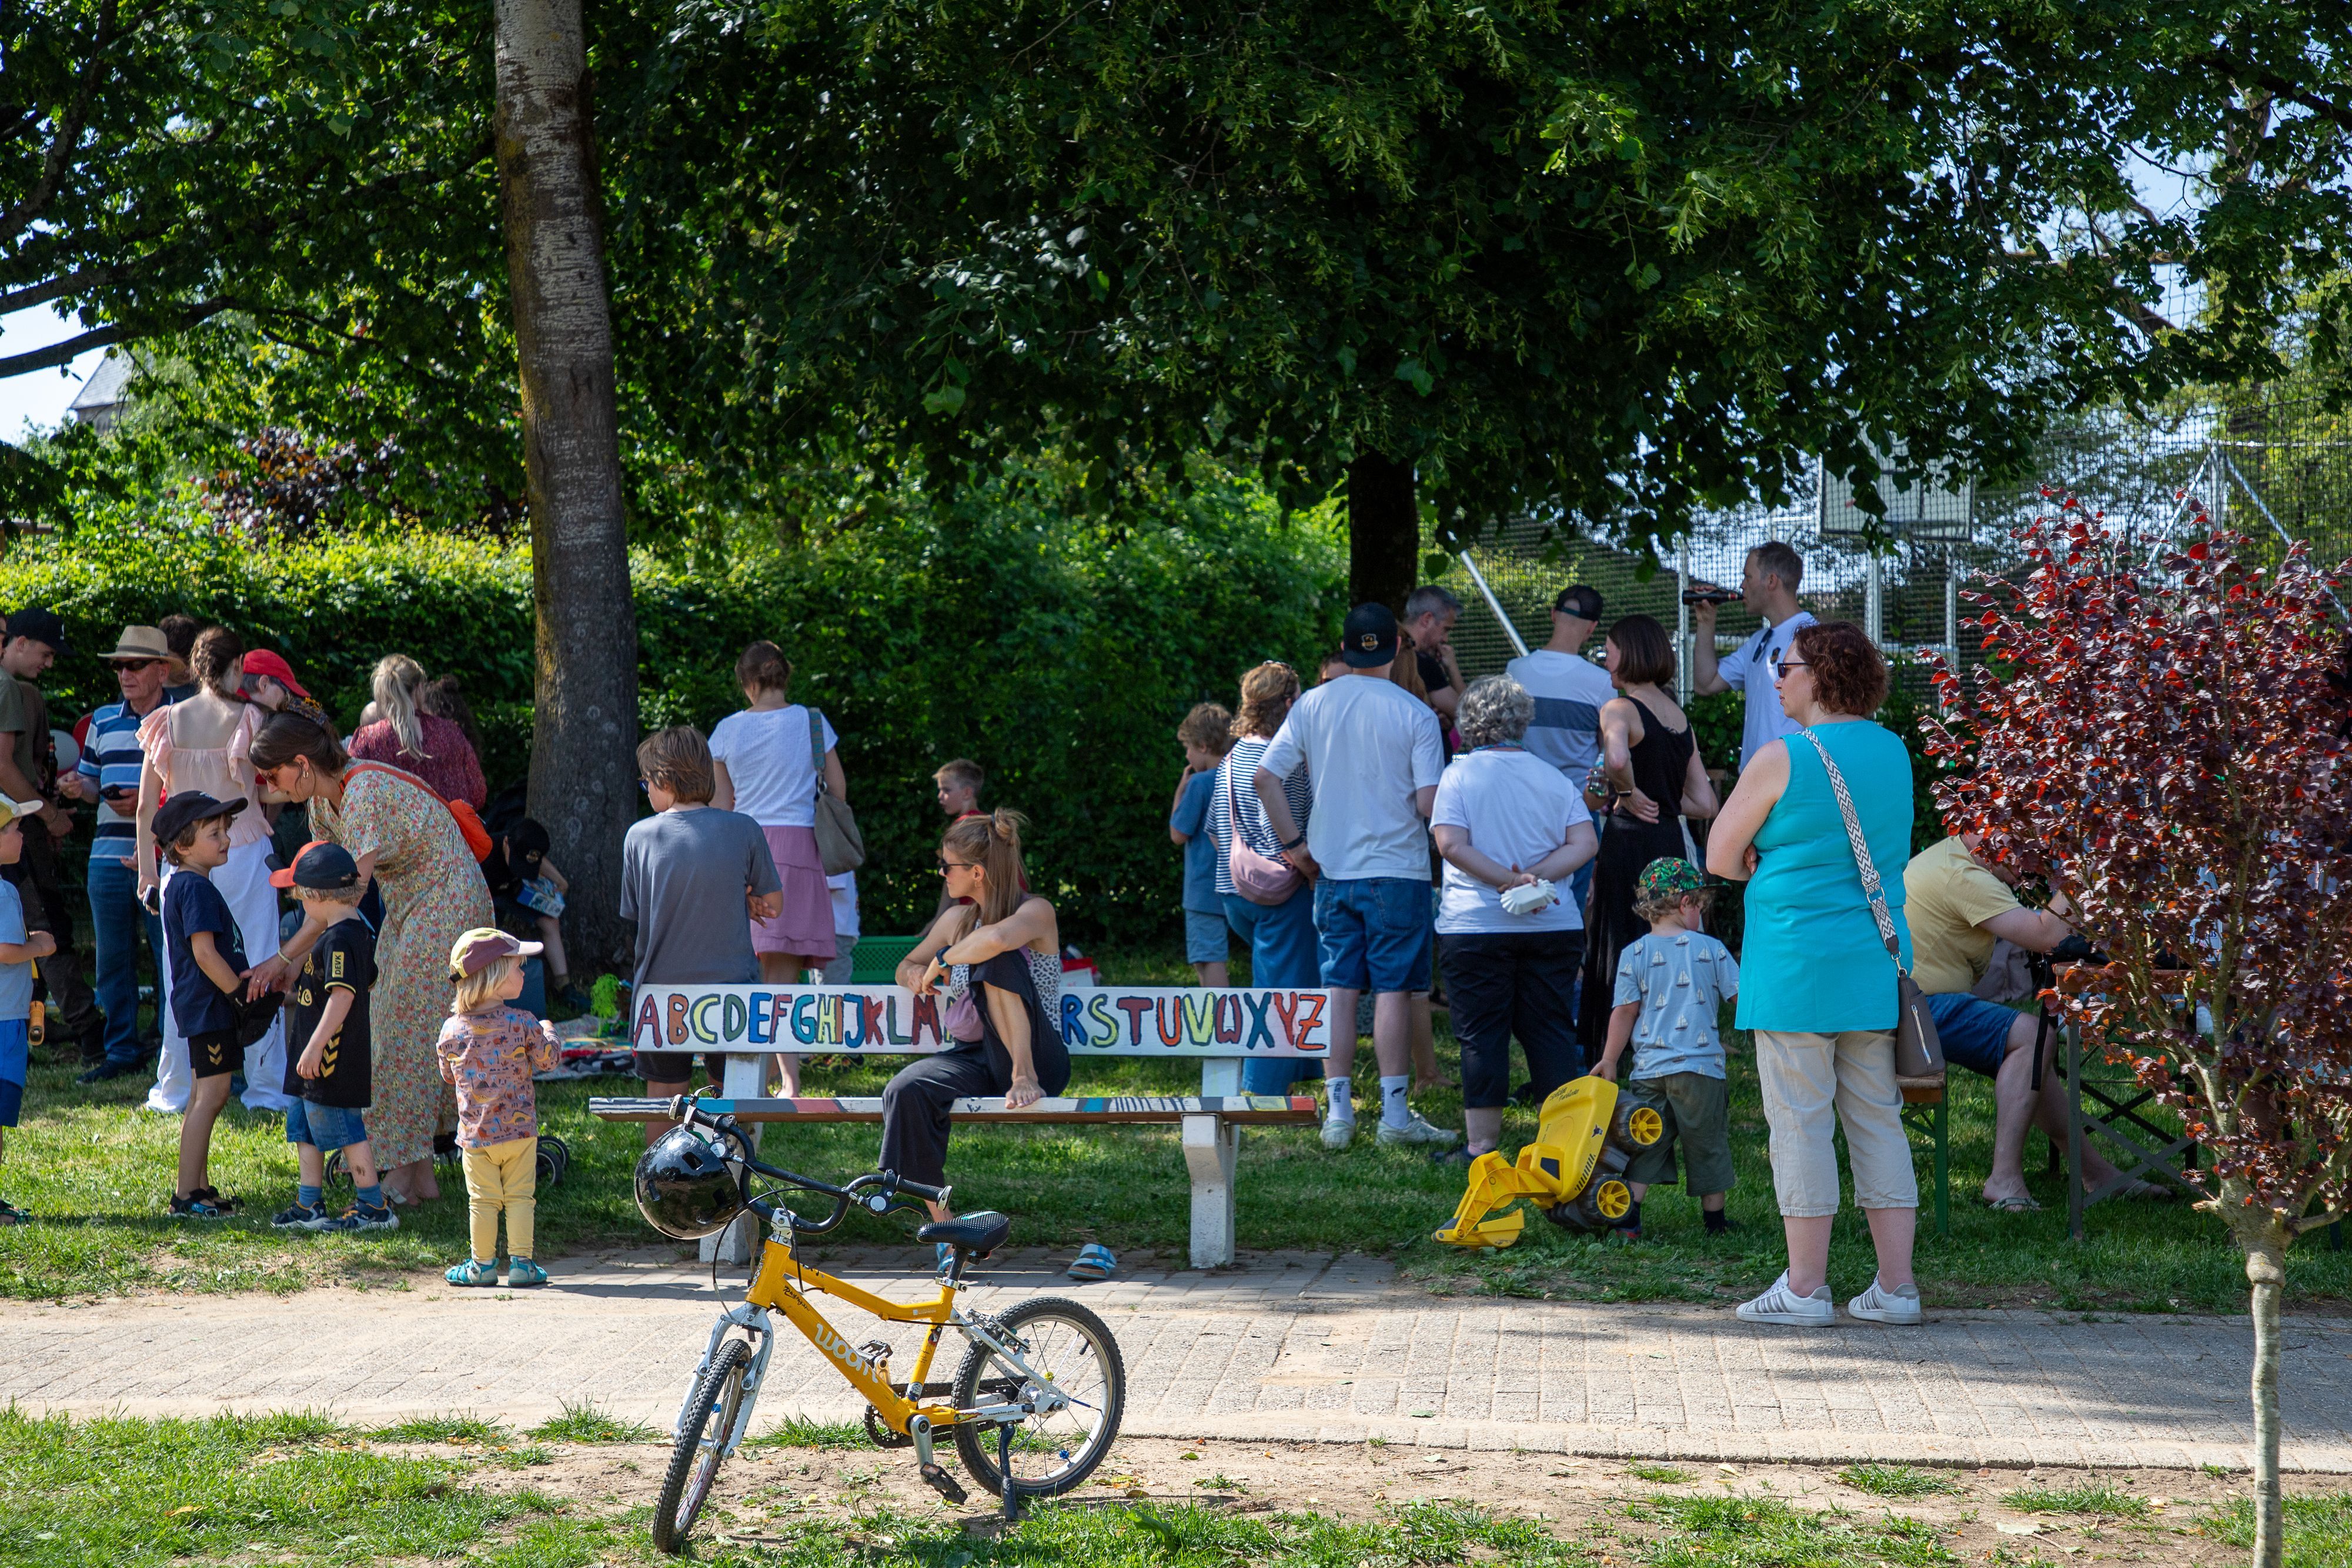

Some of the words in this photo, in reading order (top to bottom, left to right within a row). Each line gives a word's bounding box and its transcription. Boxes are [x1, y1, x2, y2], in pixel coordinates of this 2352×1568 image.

[634, 991, 954, 1048] ABCDEFGHIJKLM
[1061, 991, 1327, 1051] RSTUVWXYZ
[814, 1323, 878, 1383] woom
